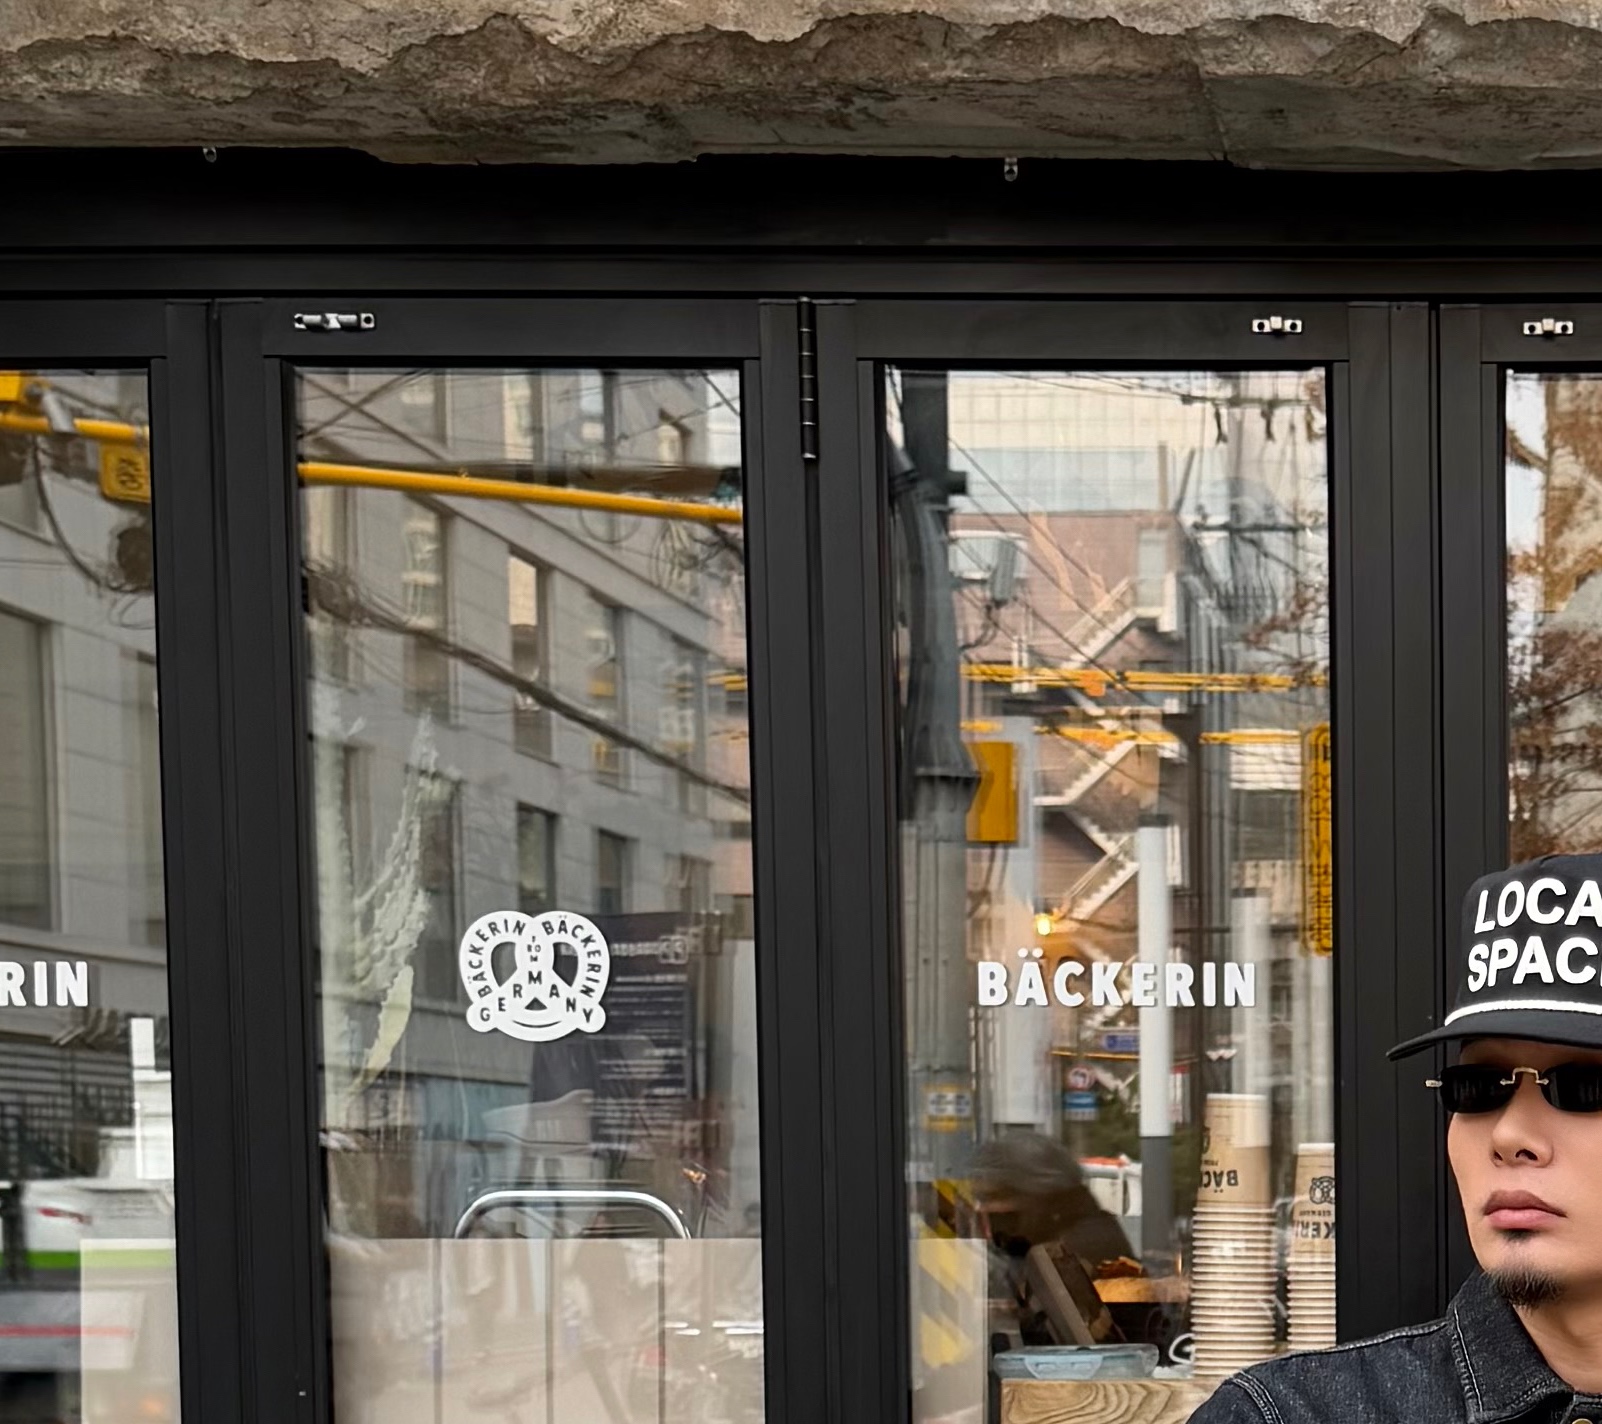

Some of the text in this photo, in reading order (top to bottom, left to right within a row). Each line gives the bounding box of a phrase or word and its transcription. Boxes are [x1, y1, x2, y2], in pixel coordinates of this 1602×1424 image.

[467, 914, 602, 998] BÄCKERIN BÄCKERIN
[977, 948, 1256, 1007] BÄCKERIN
[0, 961, 88, 1007] RIN
[479, 970, 594, 1023] GERMANY
[1200, 1169, 1239, 1193] BÄC
[1292, 1221, 1335, 1240] KERI
